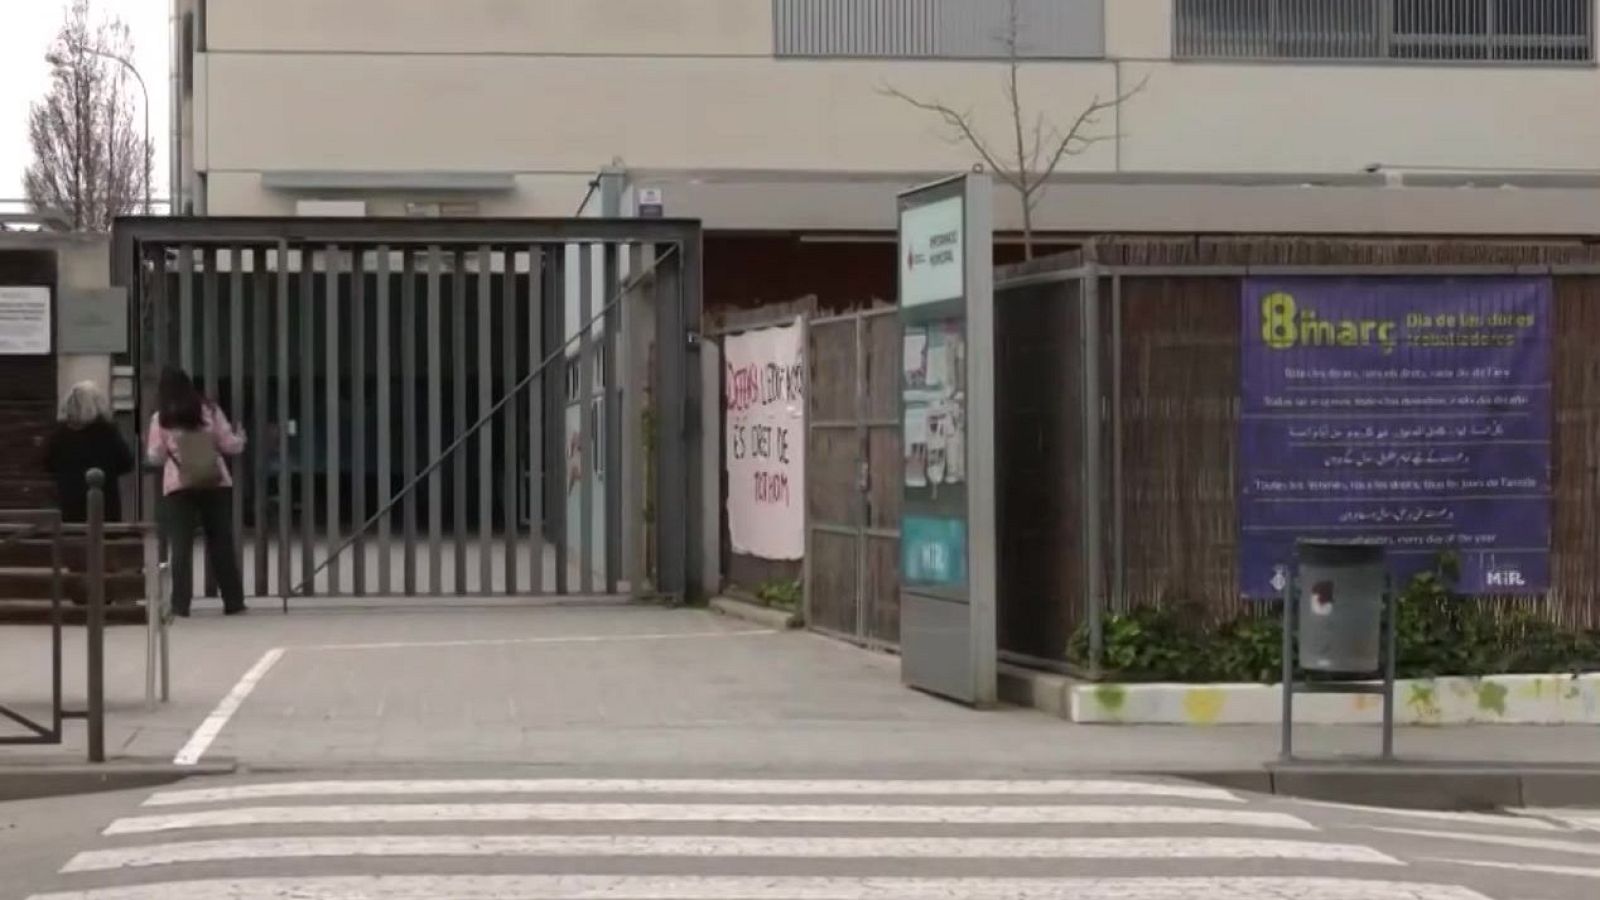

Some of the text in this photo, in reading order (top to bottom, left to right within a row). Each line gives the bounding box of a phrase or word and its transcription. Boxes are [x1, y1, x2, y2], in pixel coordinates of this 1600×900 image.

[1260, 291, 1396, 355] 8 març
[1435, 313, 1456, 328] de
